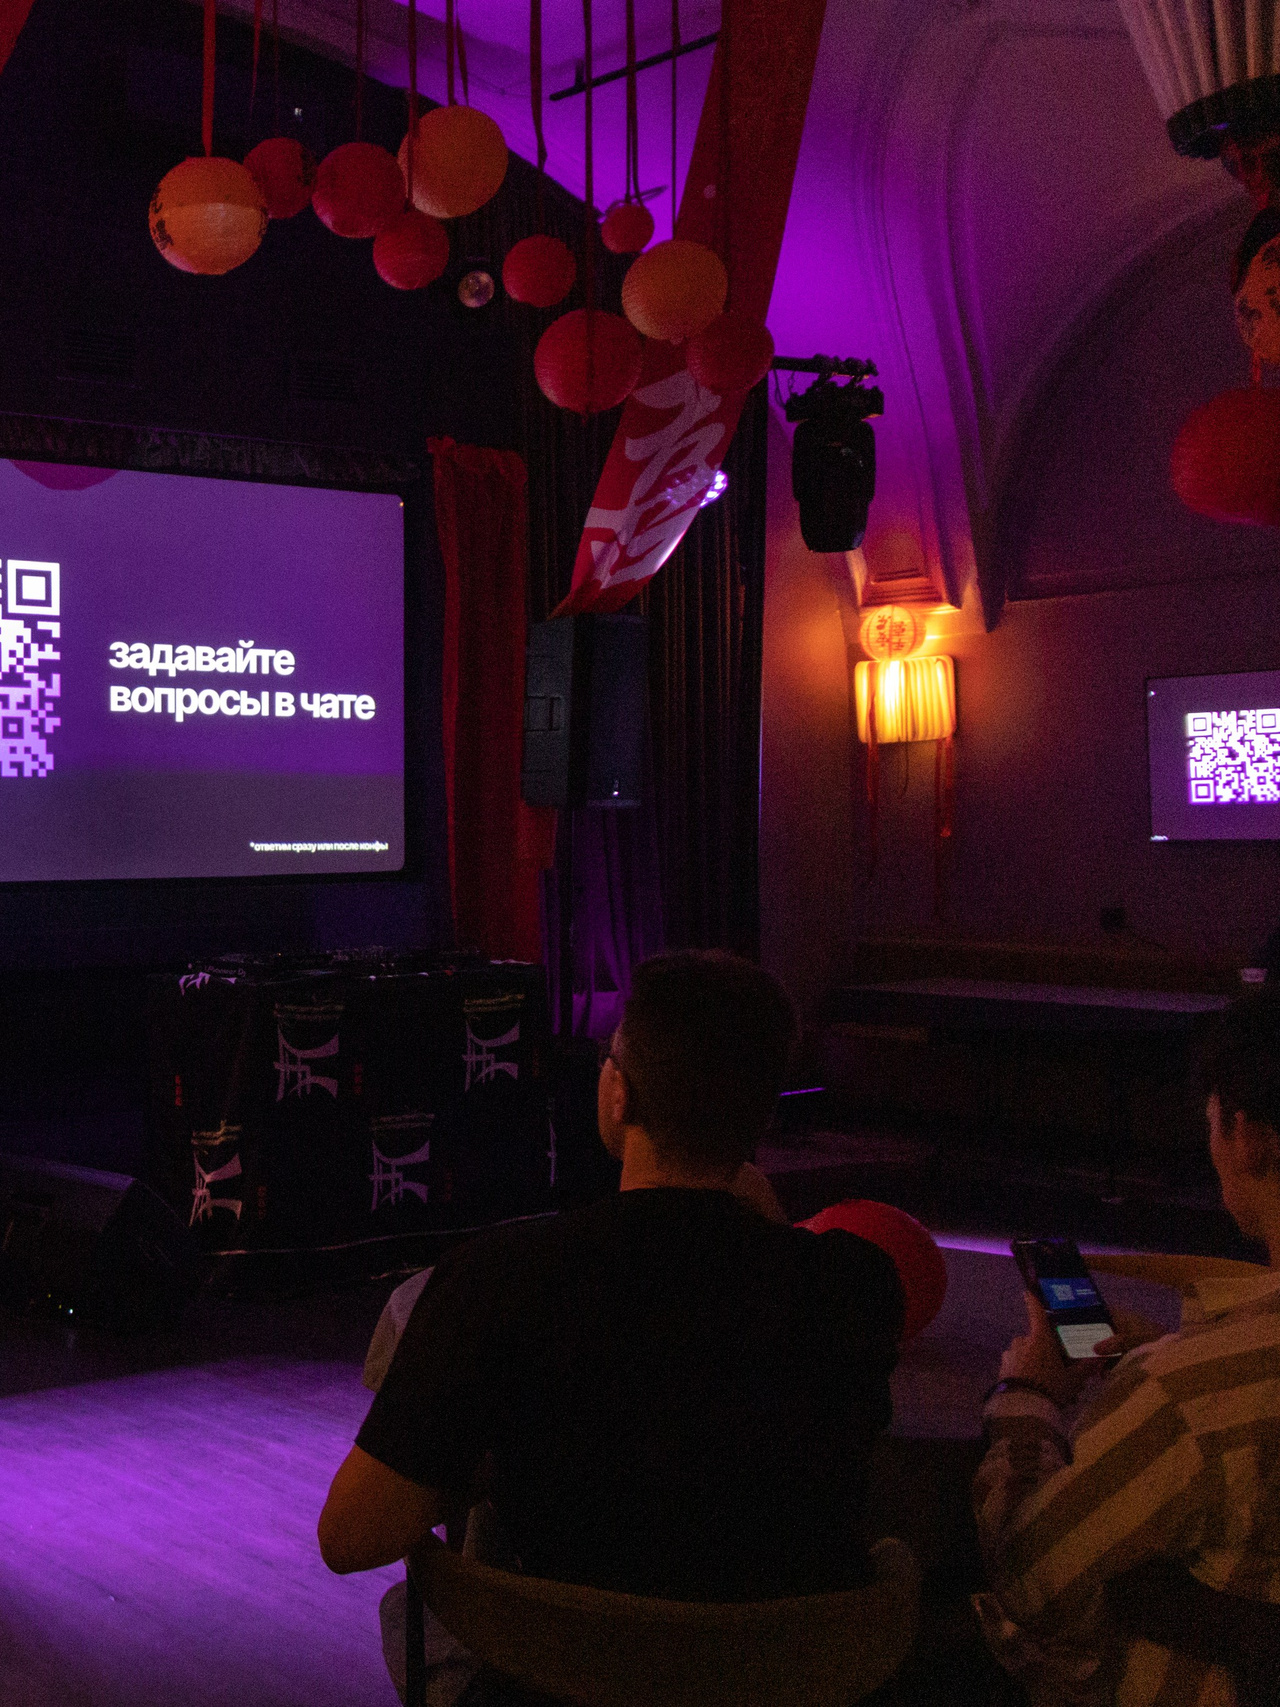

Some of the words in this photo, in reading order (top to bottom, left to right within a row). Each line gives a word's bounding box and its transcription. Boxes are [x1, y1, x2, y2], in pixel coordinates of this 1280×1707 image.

[109, 640, 296, 677] задавайте
[110, 685, 270, 722] вопросы
[274, 691, 296, 717] в
[300, 692, 376, 720] чате
[334, 843, 359, 851] после
